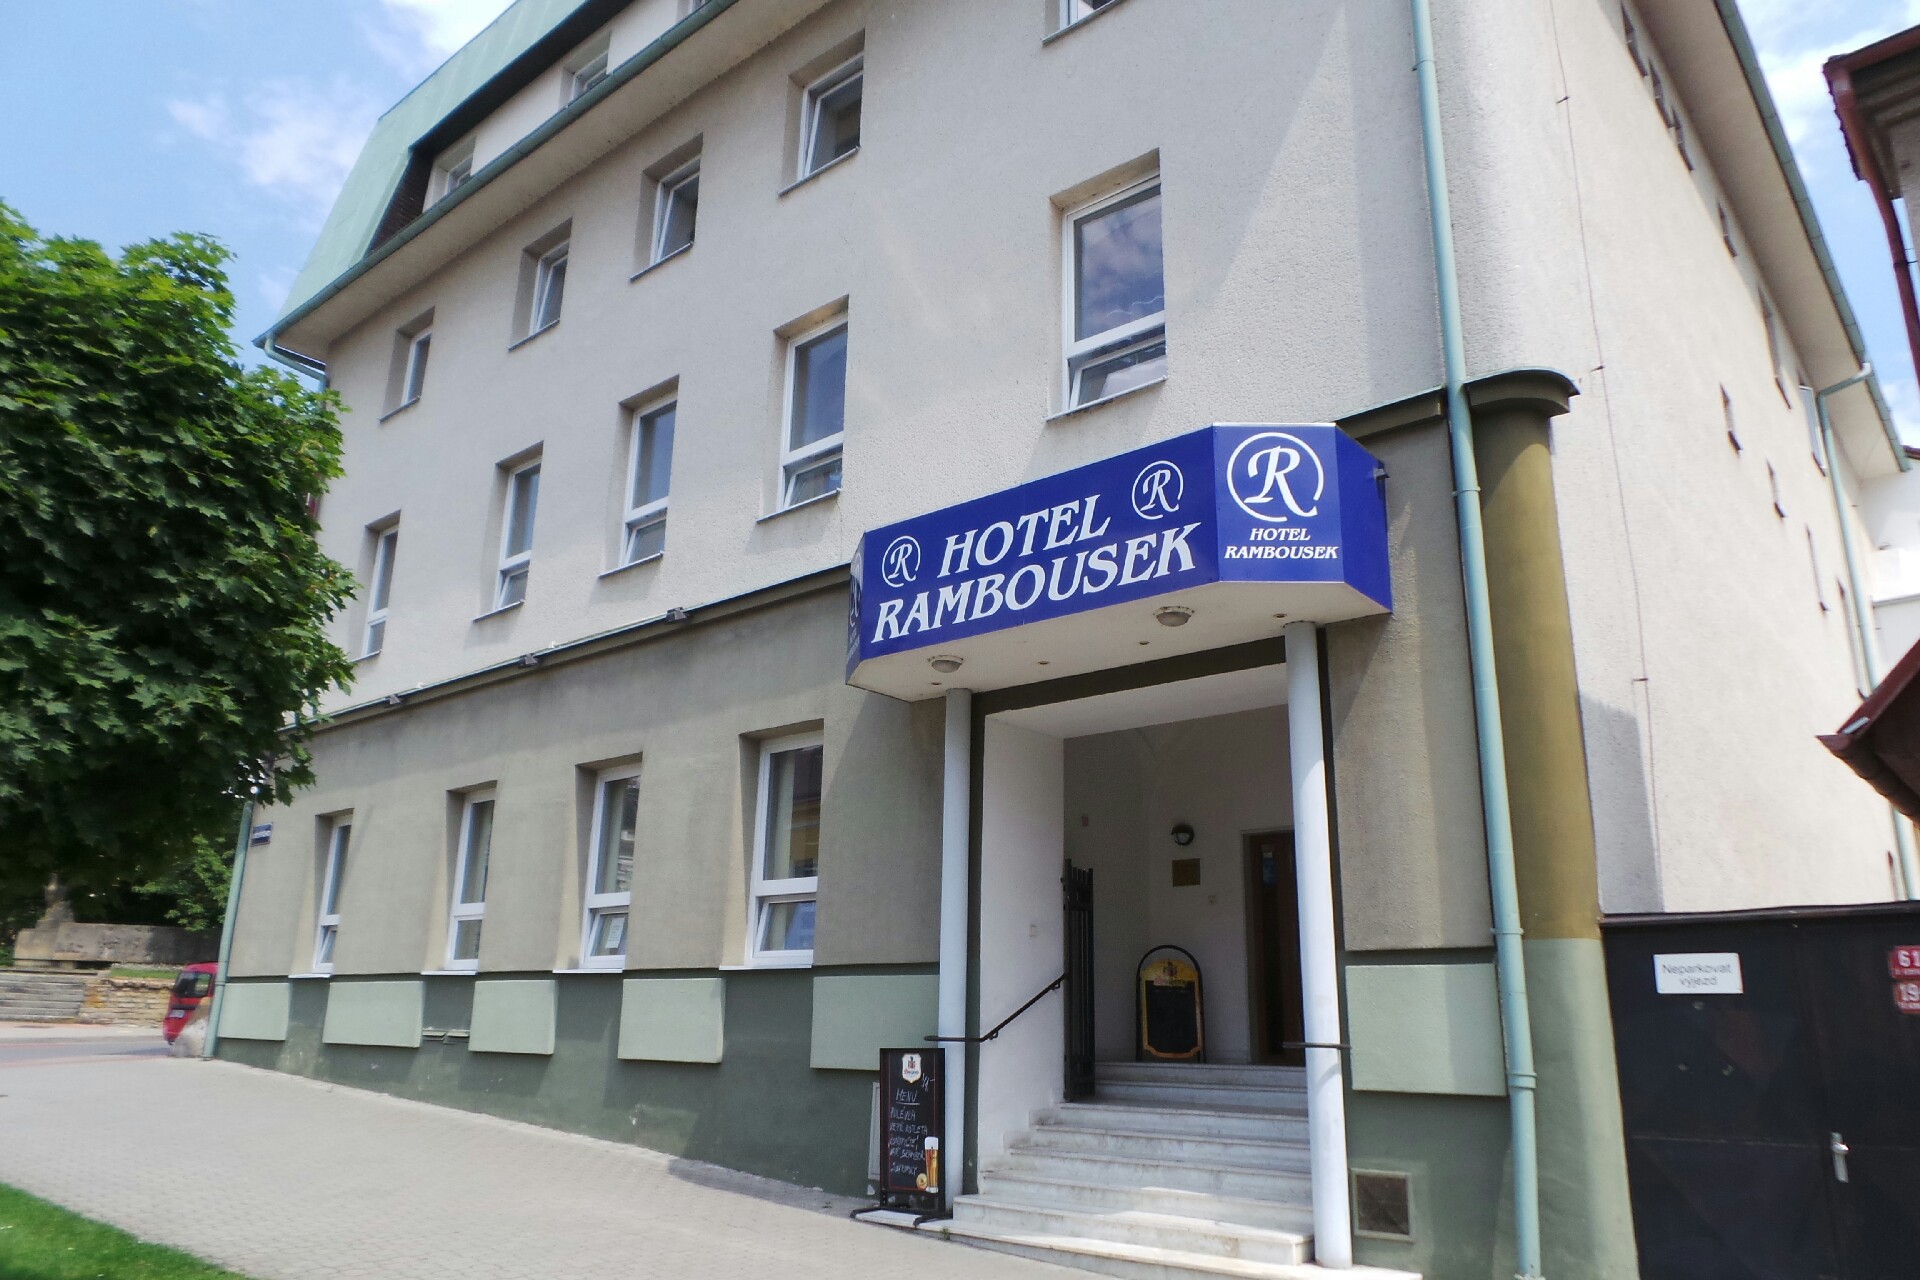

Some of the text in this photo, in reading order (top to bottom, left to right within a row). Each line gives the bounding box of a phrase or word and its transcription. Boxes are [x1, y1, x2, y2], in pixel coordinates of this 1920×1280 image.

[1247, 447, 1317, 517] R
[937, 494, 1111, 578] HOTEL
[1249, 526, 1312, 542] HOTEL
[1224, 543, 1340, 560] RAMBOUSEK
[871, 522, 1201, 643] RAMBOUSEK
[1662, 963, 1731, 976] Neparkovat
[895, 1088, 918, 1102] MENU
